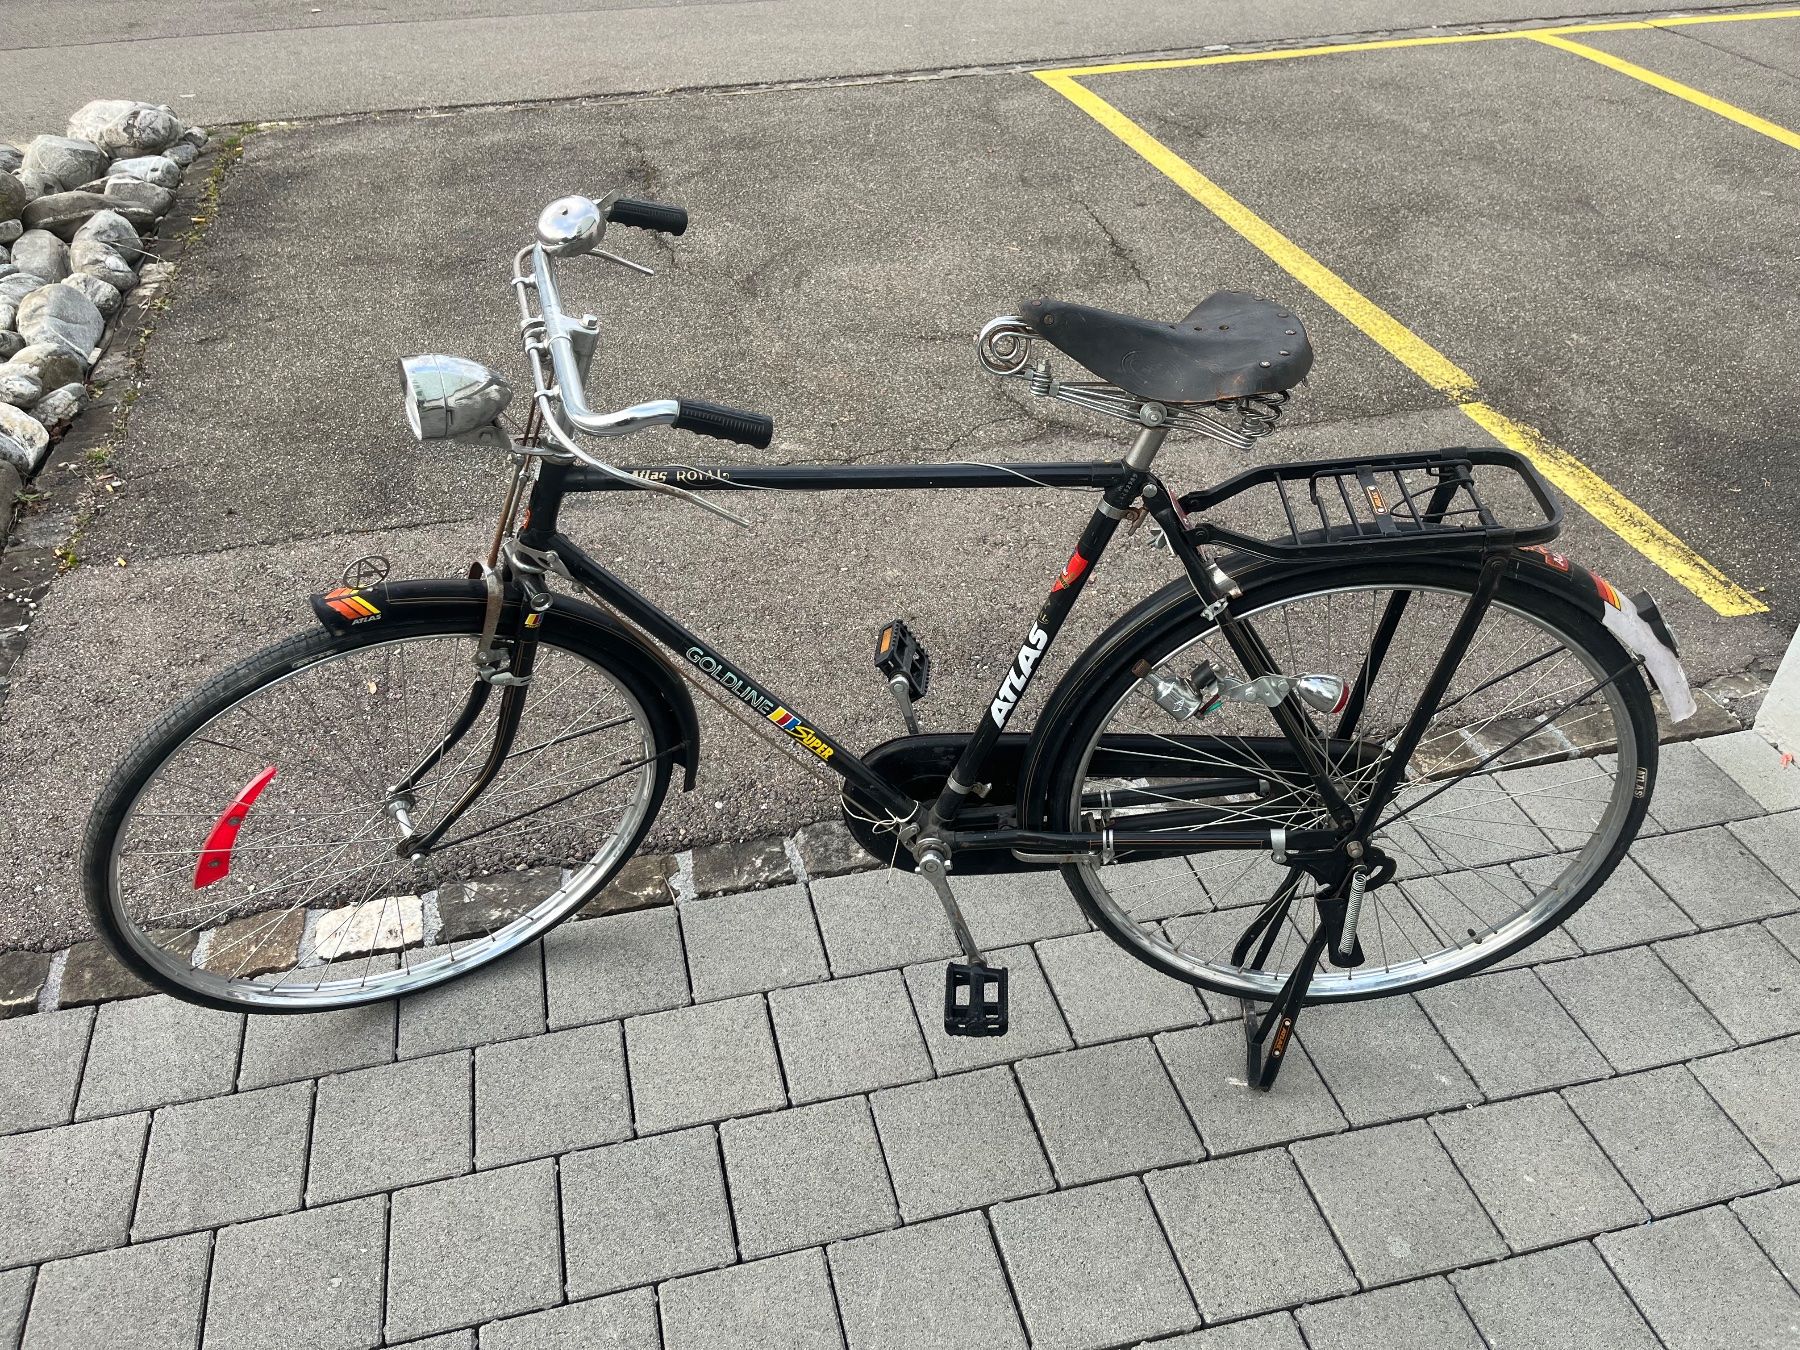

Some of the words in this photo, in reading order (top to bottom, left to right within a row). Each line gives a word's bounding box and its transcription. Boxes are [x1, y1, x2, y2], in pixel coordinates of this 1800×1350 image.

[351, 614, 382, 626] ATLAS
[685, 646, 774, 715] GOLDLINE
[990, 621, 1049, 729] ATLAS
